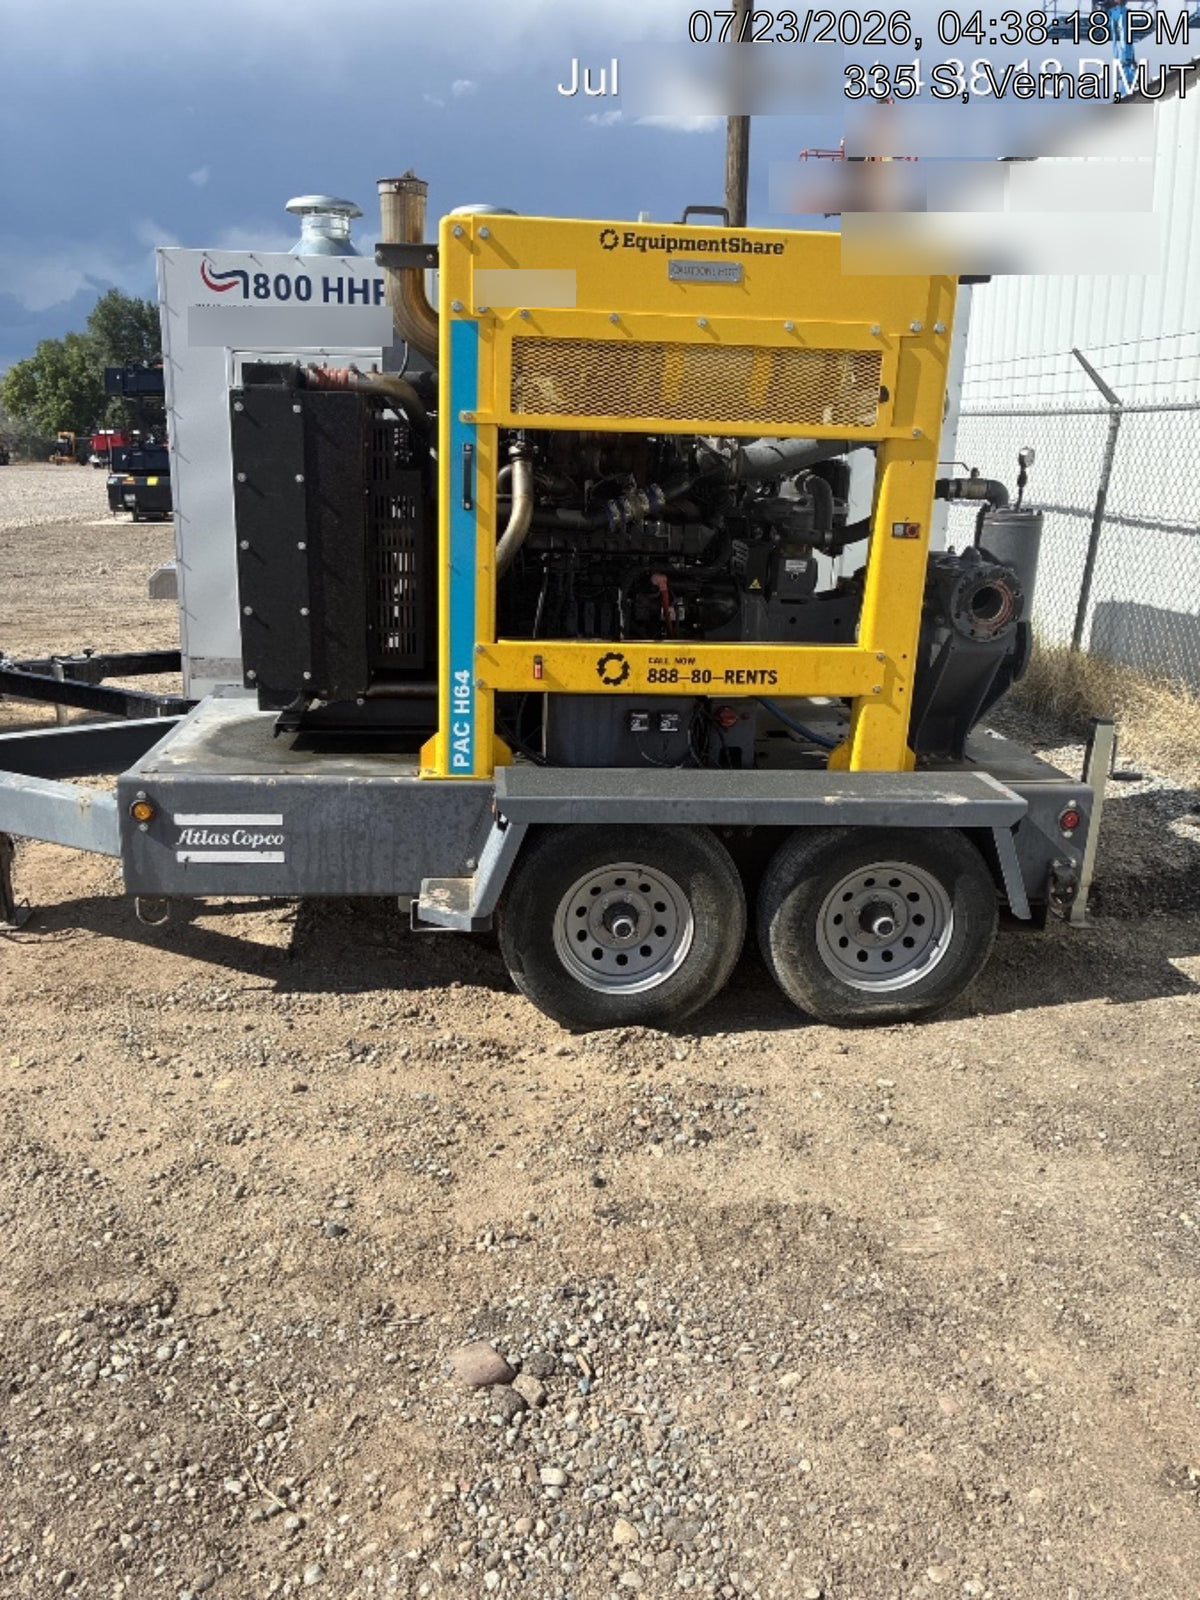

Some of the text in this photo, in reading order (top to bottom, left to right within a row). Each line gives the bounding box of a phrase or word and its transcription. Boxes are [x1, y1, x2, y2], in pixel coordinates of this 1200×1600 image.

[622, 232, 786, 256] EquipmentShare
[675, 657, 696, 666] NOW
[453, 669, 470, 768] PAC H64
[176, 827, 285, 849] Atlas Copco
